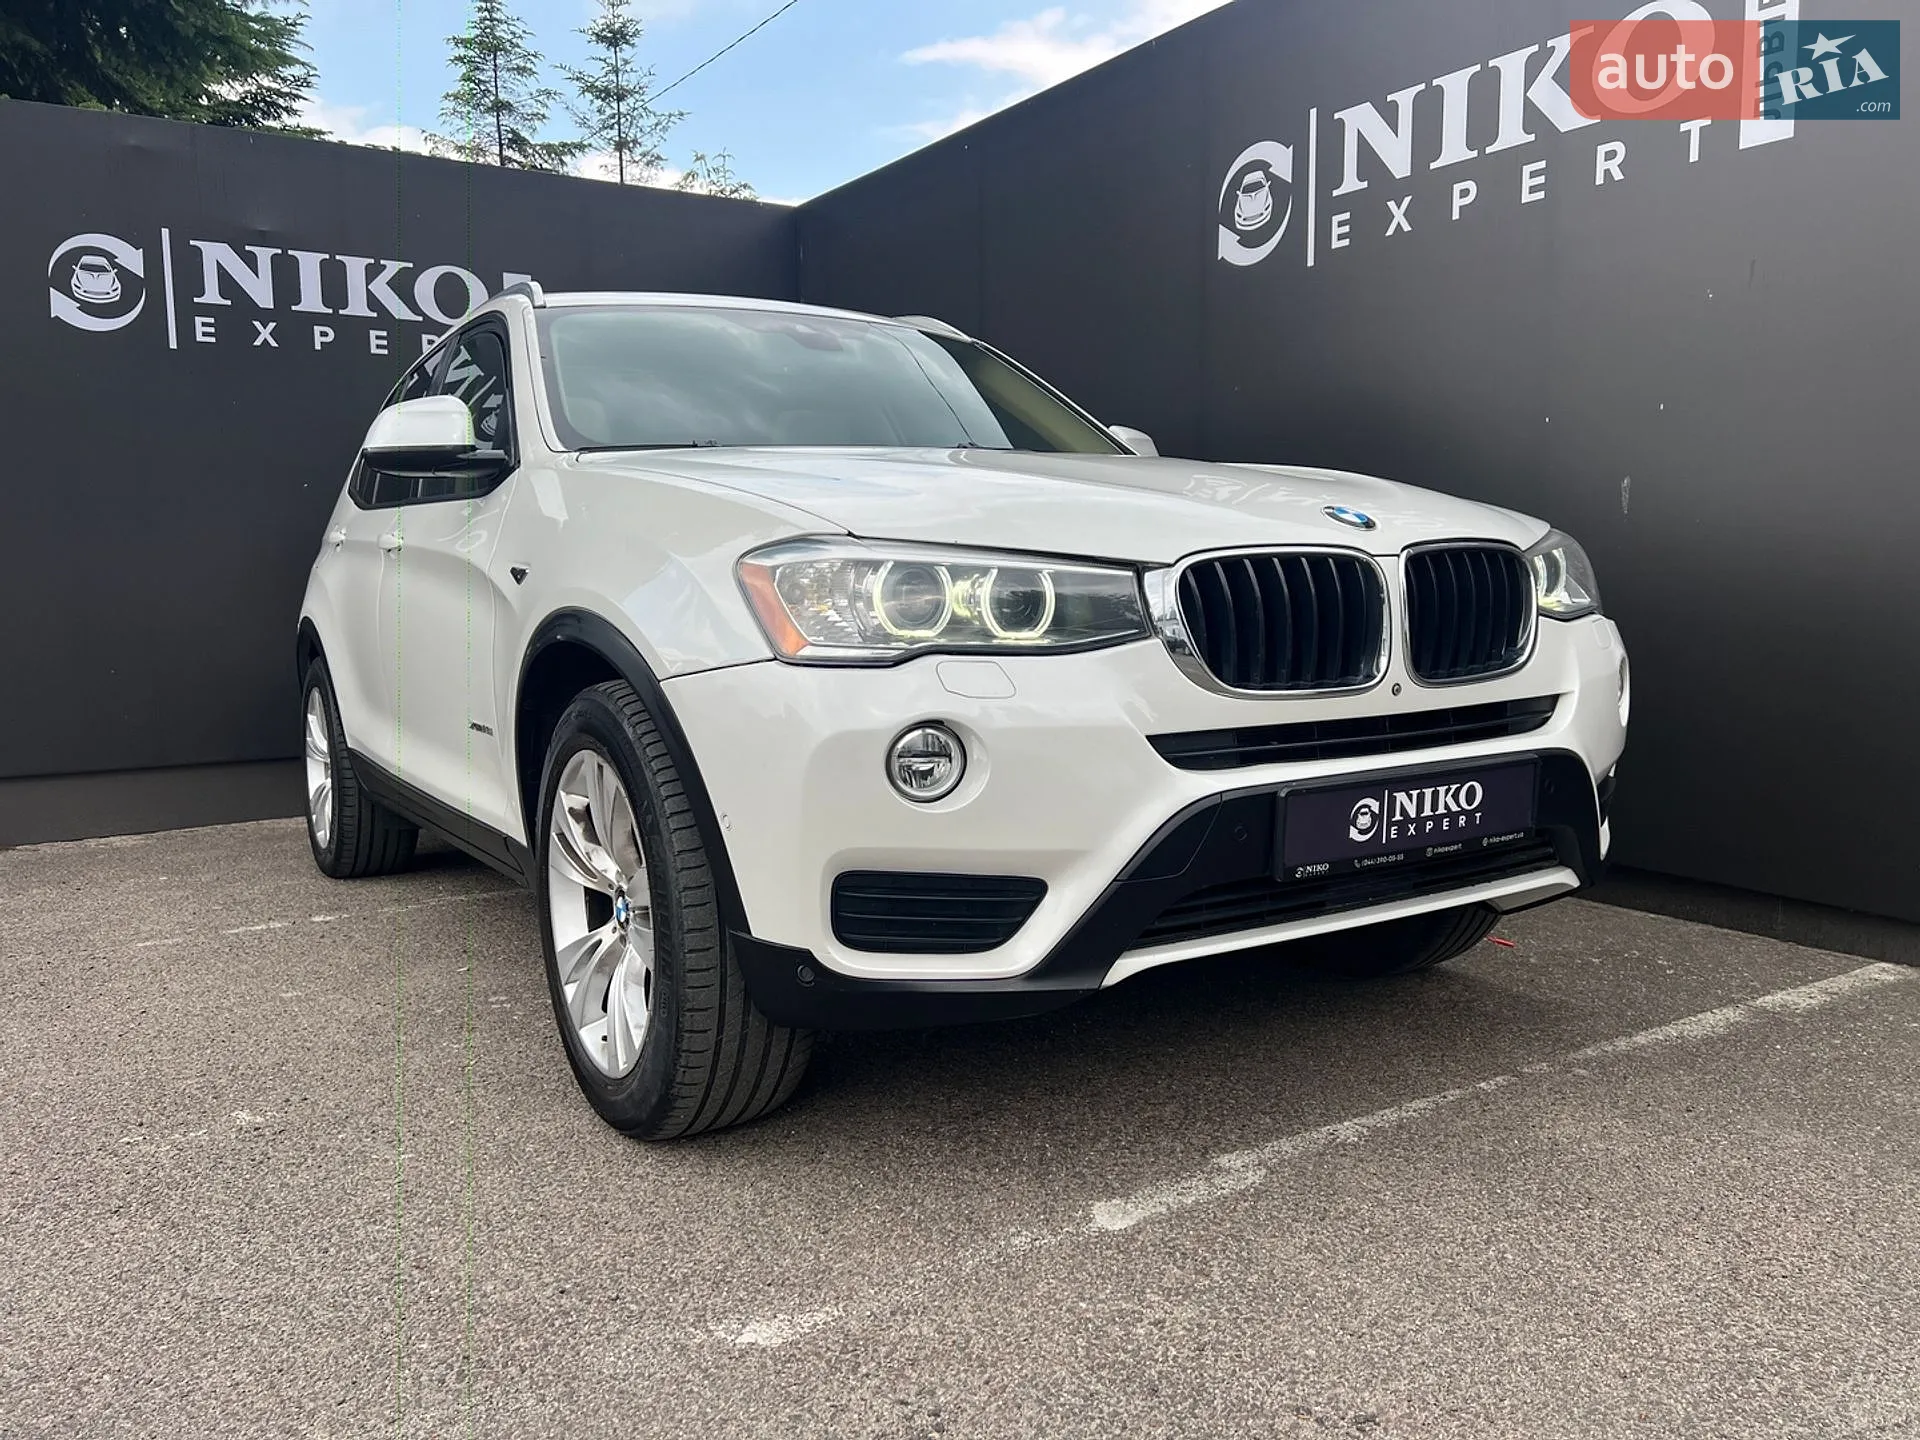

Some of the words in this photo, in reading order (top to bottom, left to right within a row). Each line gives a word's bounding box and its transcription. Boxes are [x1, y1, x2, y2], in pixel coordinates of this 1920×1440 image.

[1331, 0, 1716, 197] NIKO
[1331, 116, 1711, 249] EXPERT
[189, 239, 489, 326] NIKO
[1390, 812, 1482, 839] EXPERT
[1391, 781, 1483, 821] NIKO
